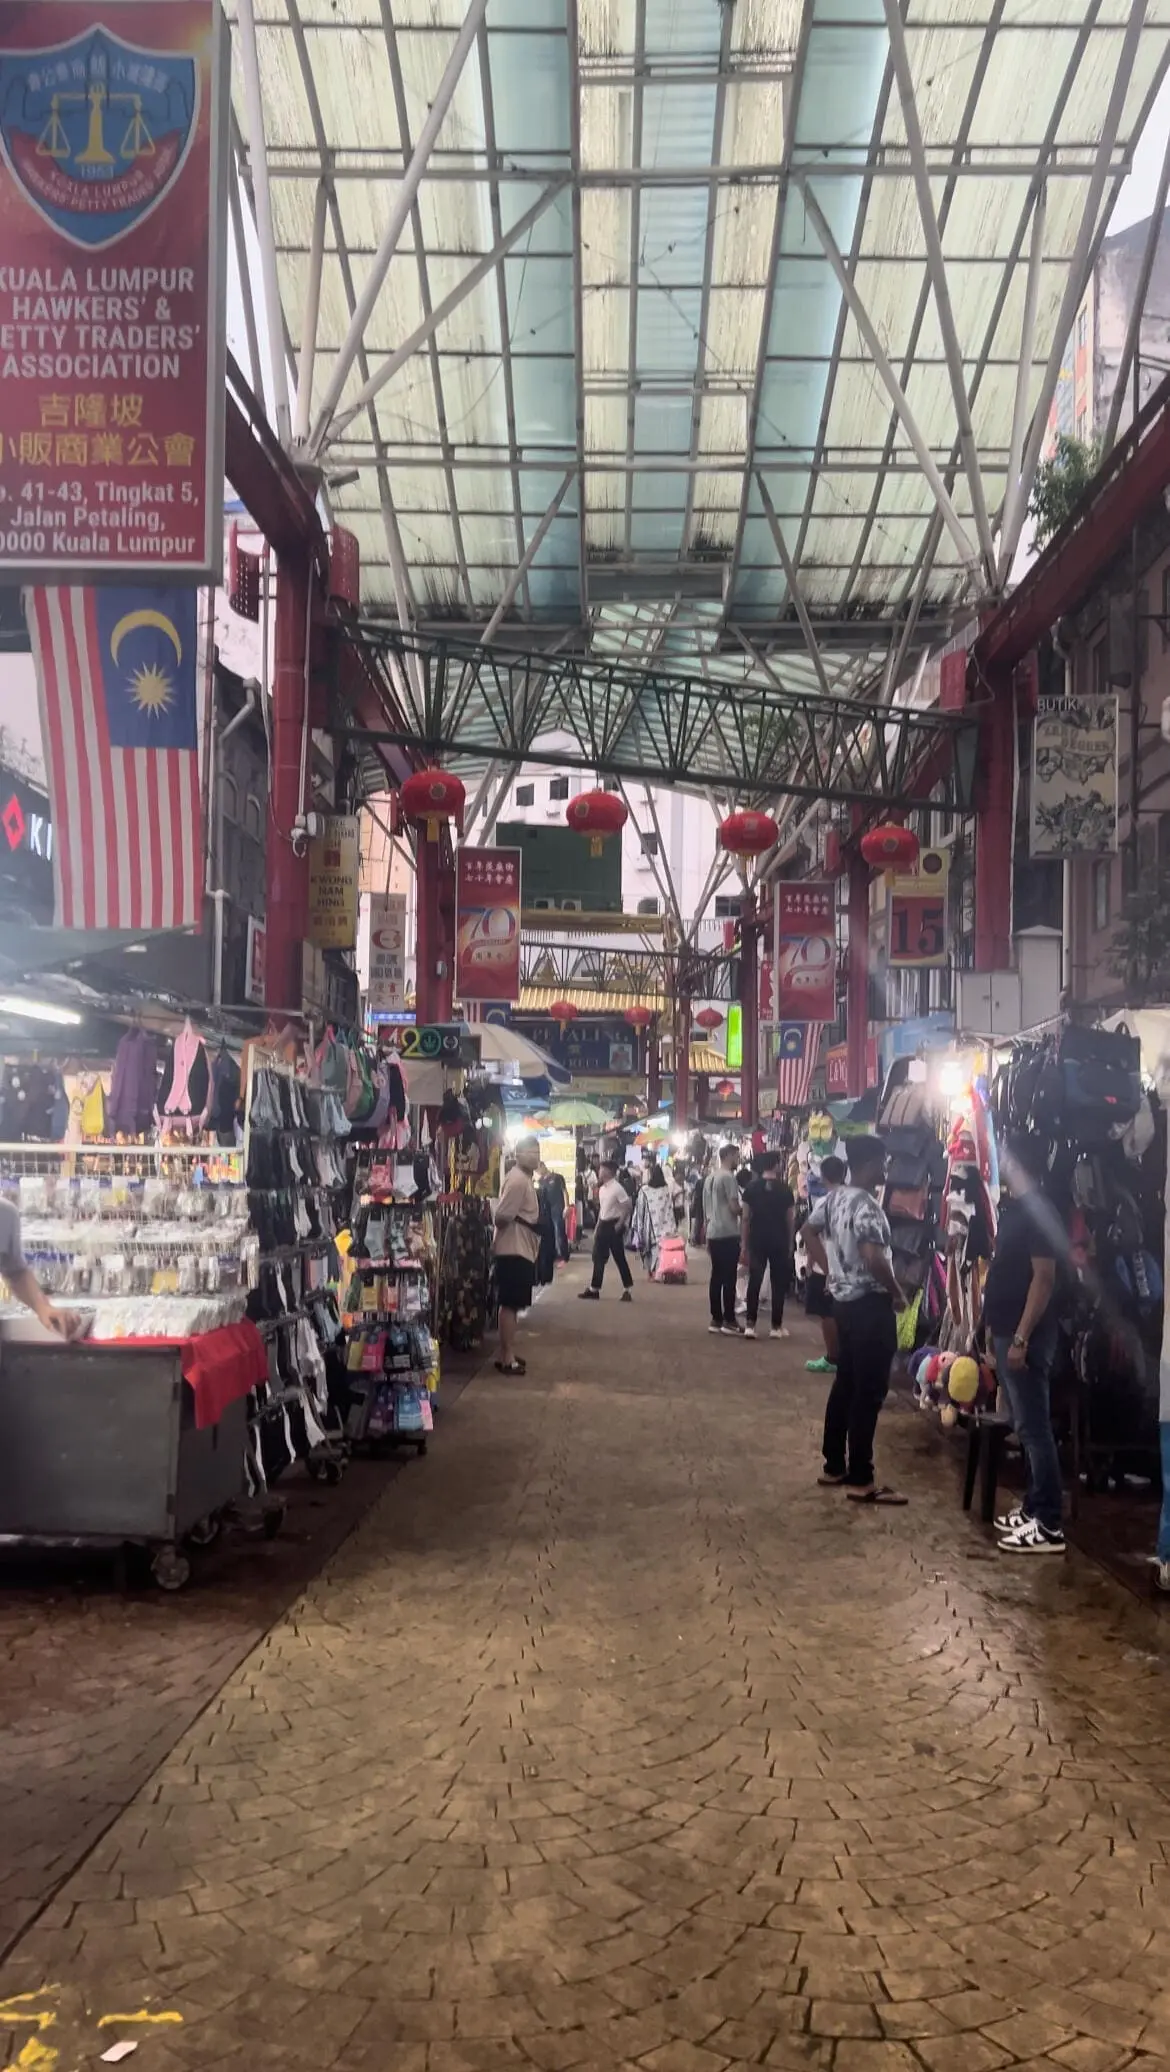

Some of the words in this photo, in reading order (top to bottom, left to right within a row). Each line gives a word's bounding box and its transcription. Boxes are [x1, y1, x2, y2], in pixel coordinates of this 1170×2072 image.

[86, 267, 194, 292] LUMPUR
[13, 296, 146, 321] HAWKERS'
[155, 296, 172, 321] &
[75, 324, 200, 350] TRADERS'
[3, 354, 180, 379] ASSOCIATION
[39, 393, 144, 428] 吉隆坡
[21, 482, 88, 505] 41-43,
[95, 481, 175, 507] Tingkat
[181, 482, 199, 505] 5,
[10, 505, 67, 528] Jalan
[73, 506, 166, 532] Petaling,
[53, 532, 110, 554] Kuala
[117, 532, 196, 558] Lumpur
[1037, 697, 1077, 712] BUTIK
[318, 886, 344, 897] NAM
